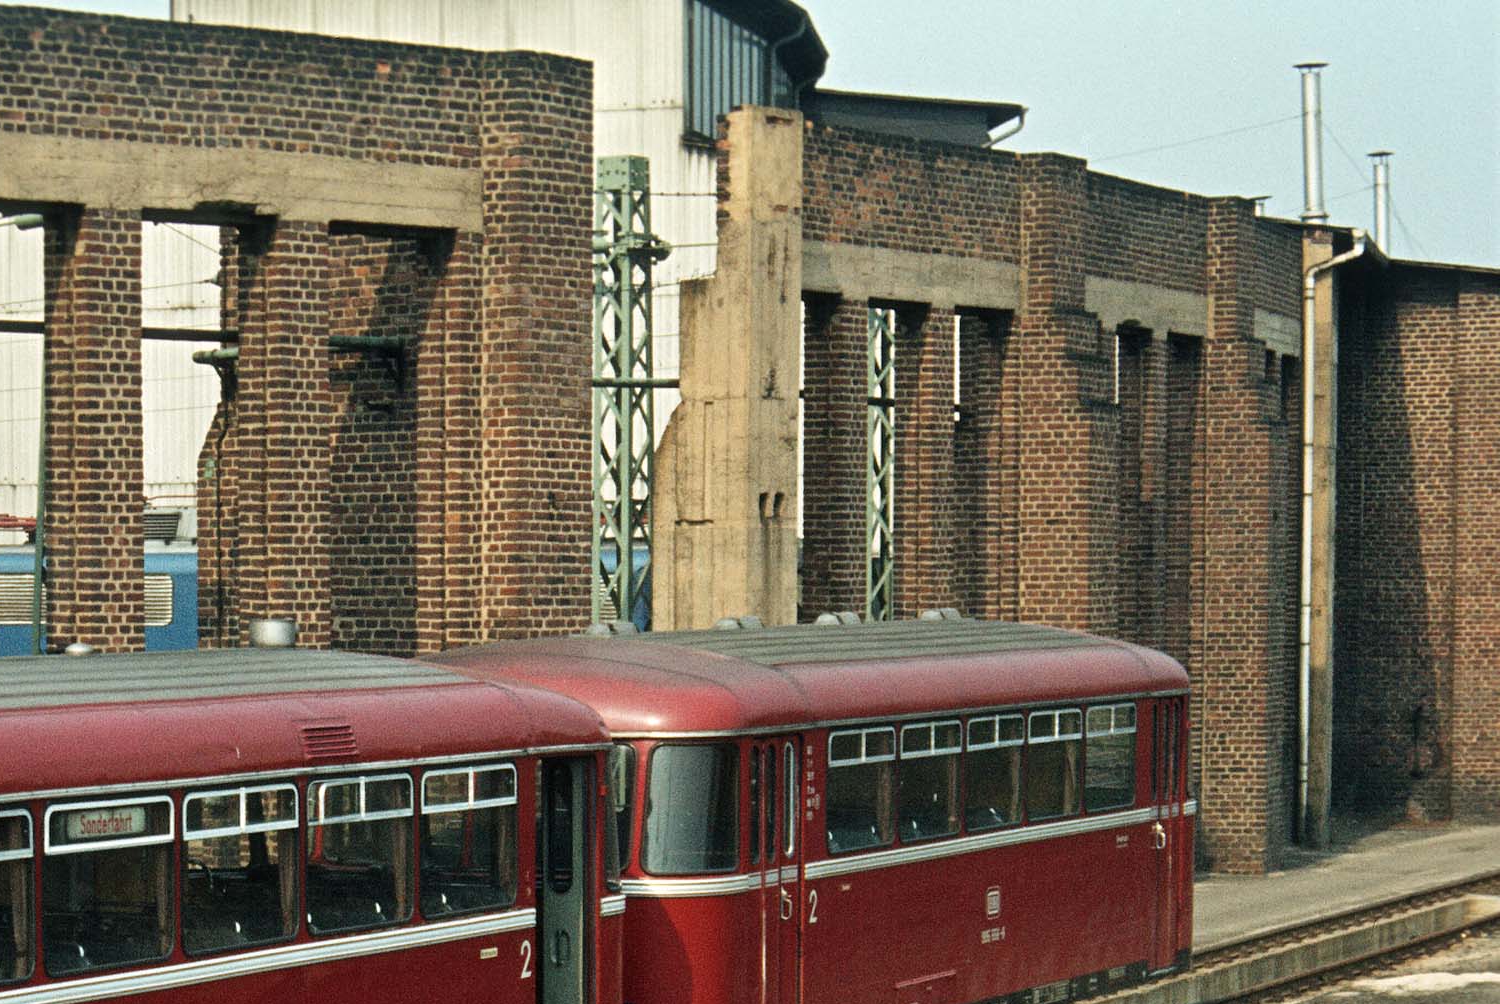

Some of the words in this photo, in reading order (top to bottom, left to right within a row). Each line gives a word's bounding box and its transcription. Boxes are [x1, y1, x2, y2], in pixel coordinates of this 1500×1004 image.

[79, 813, 133, 835] Sonderfahrt
[808, 889, 818, 923] 2
[520, 940, 533, 979] 2
